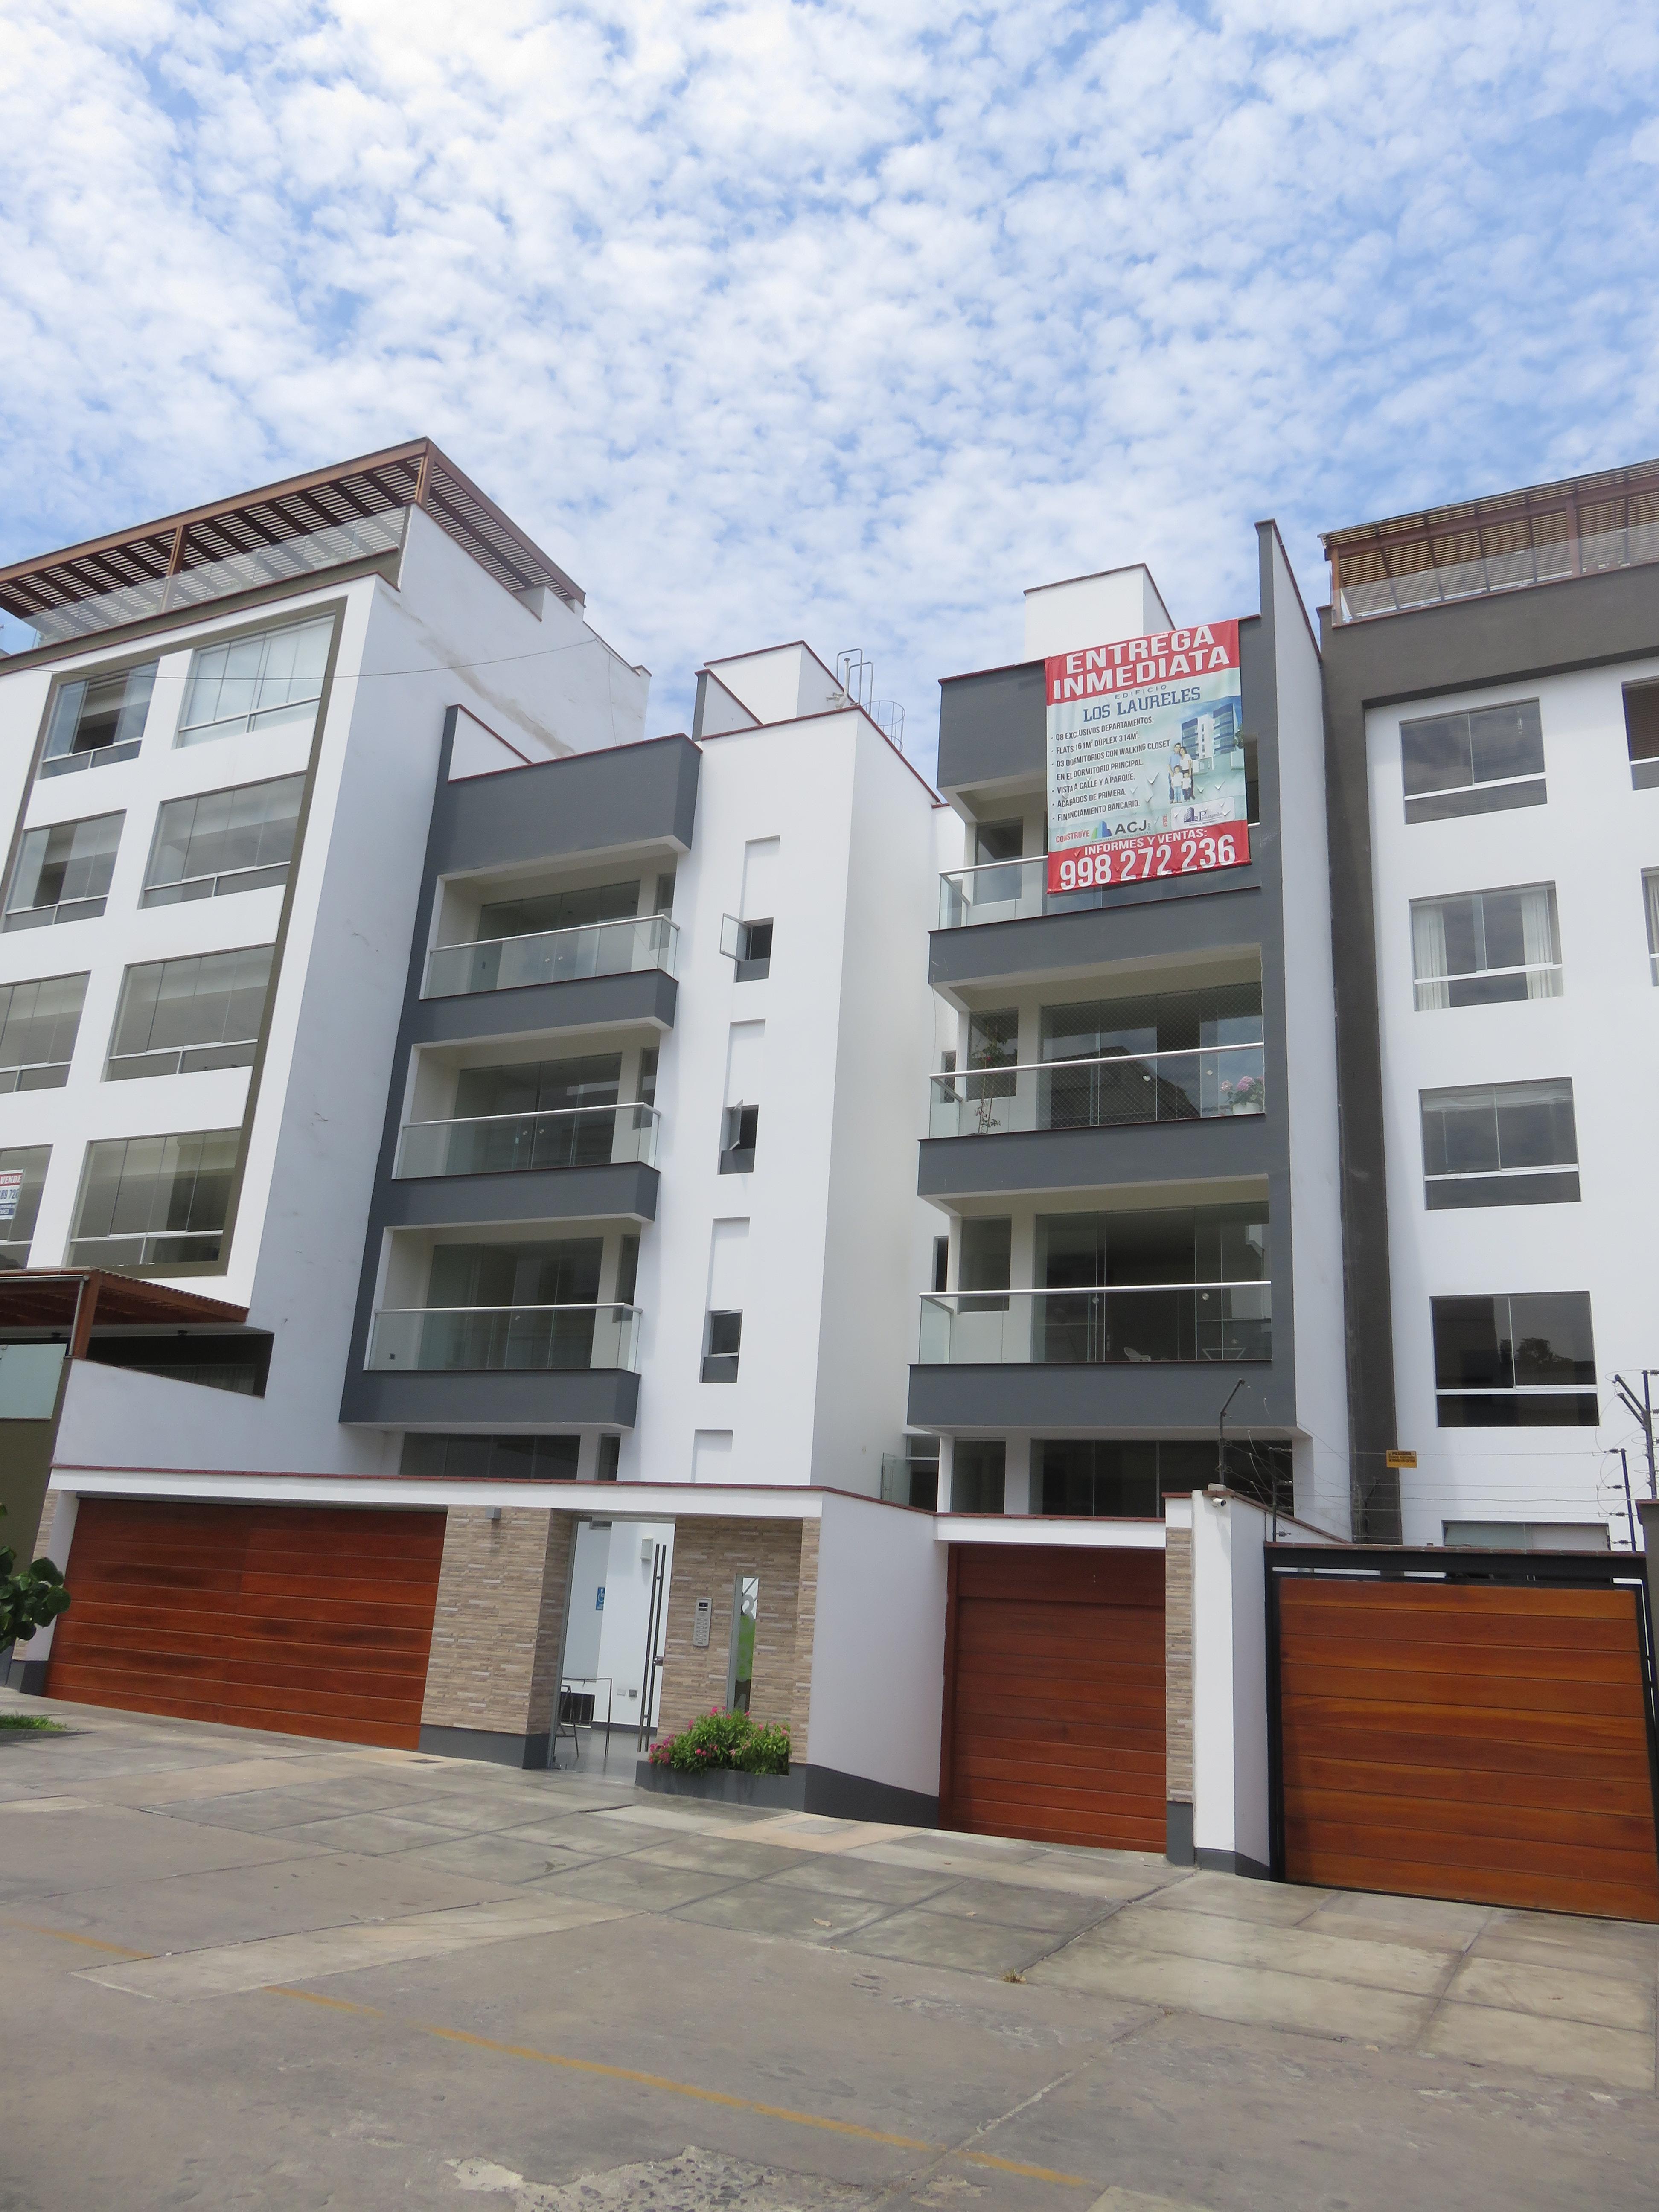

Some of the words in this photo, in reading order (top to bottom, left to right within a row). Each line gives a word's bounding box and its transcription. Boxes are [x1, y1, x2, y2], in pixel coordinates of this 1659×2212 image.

[1067, 626, 1215, 675] ENTREGA
[1054, 646, 1230, 699] INMEDIATA
[1115, 684, 1167, 699] EDIFICIO
[1083, 704, 1110, 722] LOS
[1117, 687, 1200, 716] LAURELES
[1065, 726, 1100, 739] EXCLUSIVOS
[1101, 716, 1153, 732] DEPARTAMENTOS.
[1056, 745, 1074, 754] FLATS
[1094, 736, 1117, 747] DÚPLEX
[1066, 752, 1104, 766] DORMITORIOS
[1106, 749, 1118, 757] CON
[1119, 743, 1146, 755] WALKING
[1147, 739, 1170, 750] CLOSET
[1074, 764, 1109, 777] DORMITORIO
[1057, 786, 1073, 794] VISTA
[1079, 780, 1098, 789] CALLE
[1110, 773, 1135, 783] PARQUE.
[1057, 795, 1088, 808] ACABADOS
[1089, 793, 1097, 801] DE
[1098, 788, 1126, 800] PRIMERA.
[1057, 805, 1106, 821] FINANCIAMIENTO
[1108, 800, 1140, 811] BANCARIO.
[1056, 830, 1090, 843] CONSTRUYE
[1115, 819, 1147, 835] ACJ
[1085, 838, 1144, 855] INFORMES
[1147, 836, 1155, 845] Y
[1158, 829, 1207, 844] VENTAS:
[1060, 854, 1112, 890] 998
[1120, 844, 1172, 881] 272
[1181, 834, 1235, 872] 236
[0, 1175, 21, 1185] VENDE
